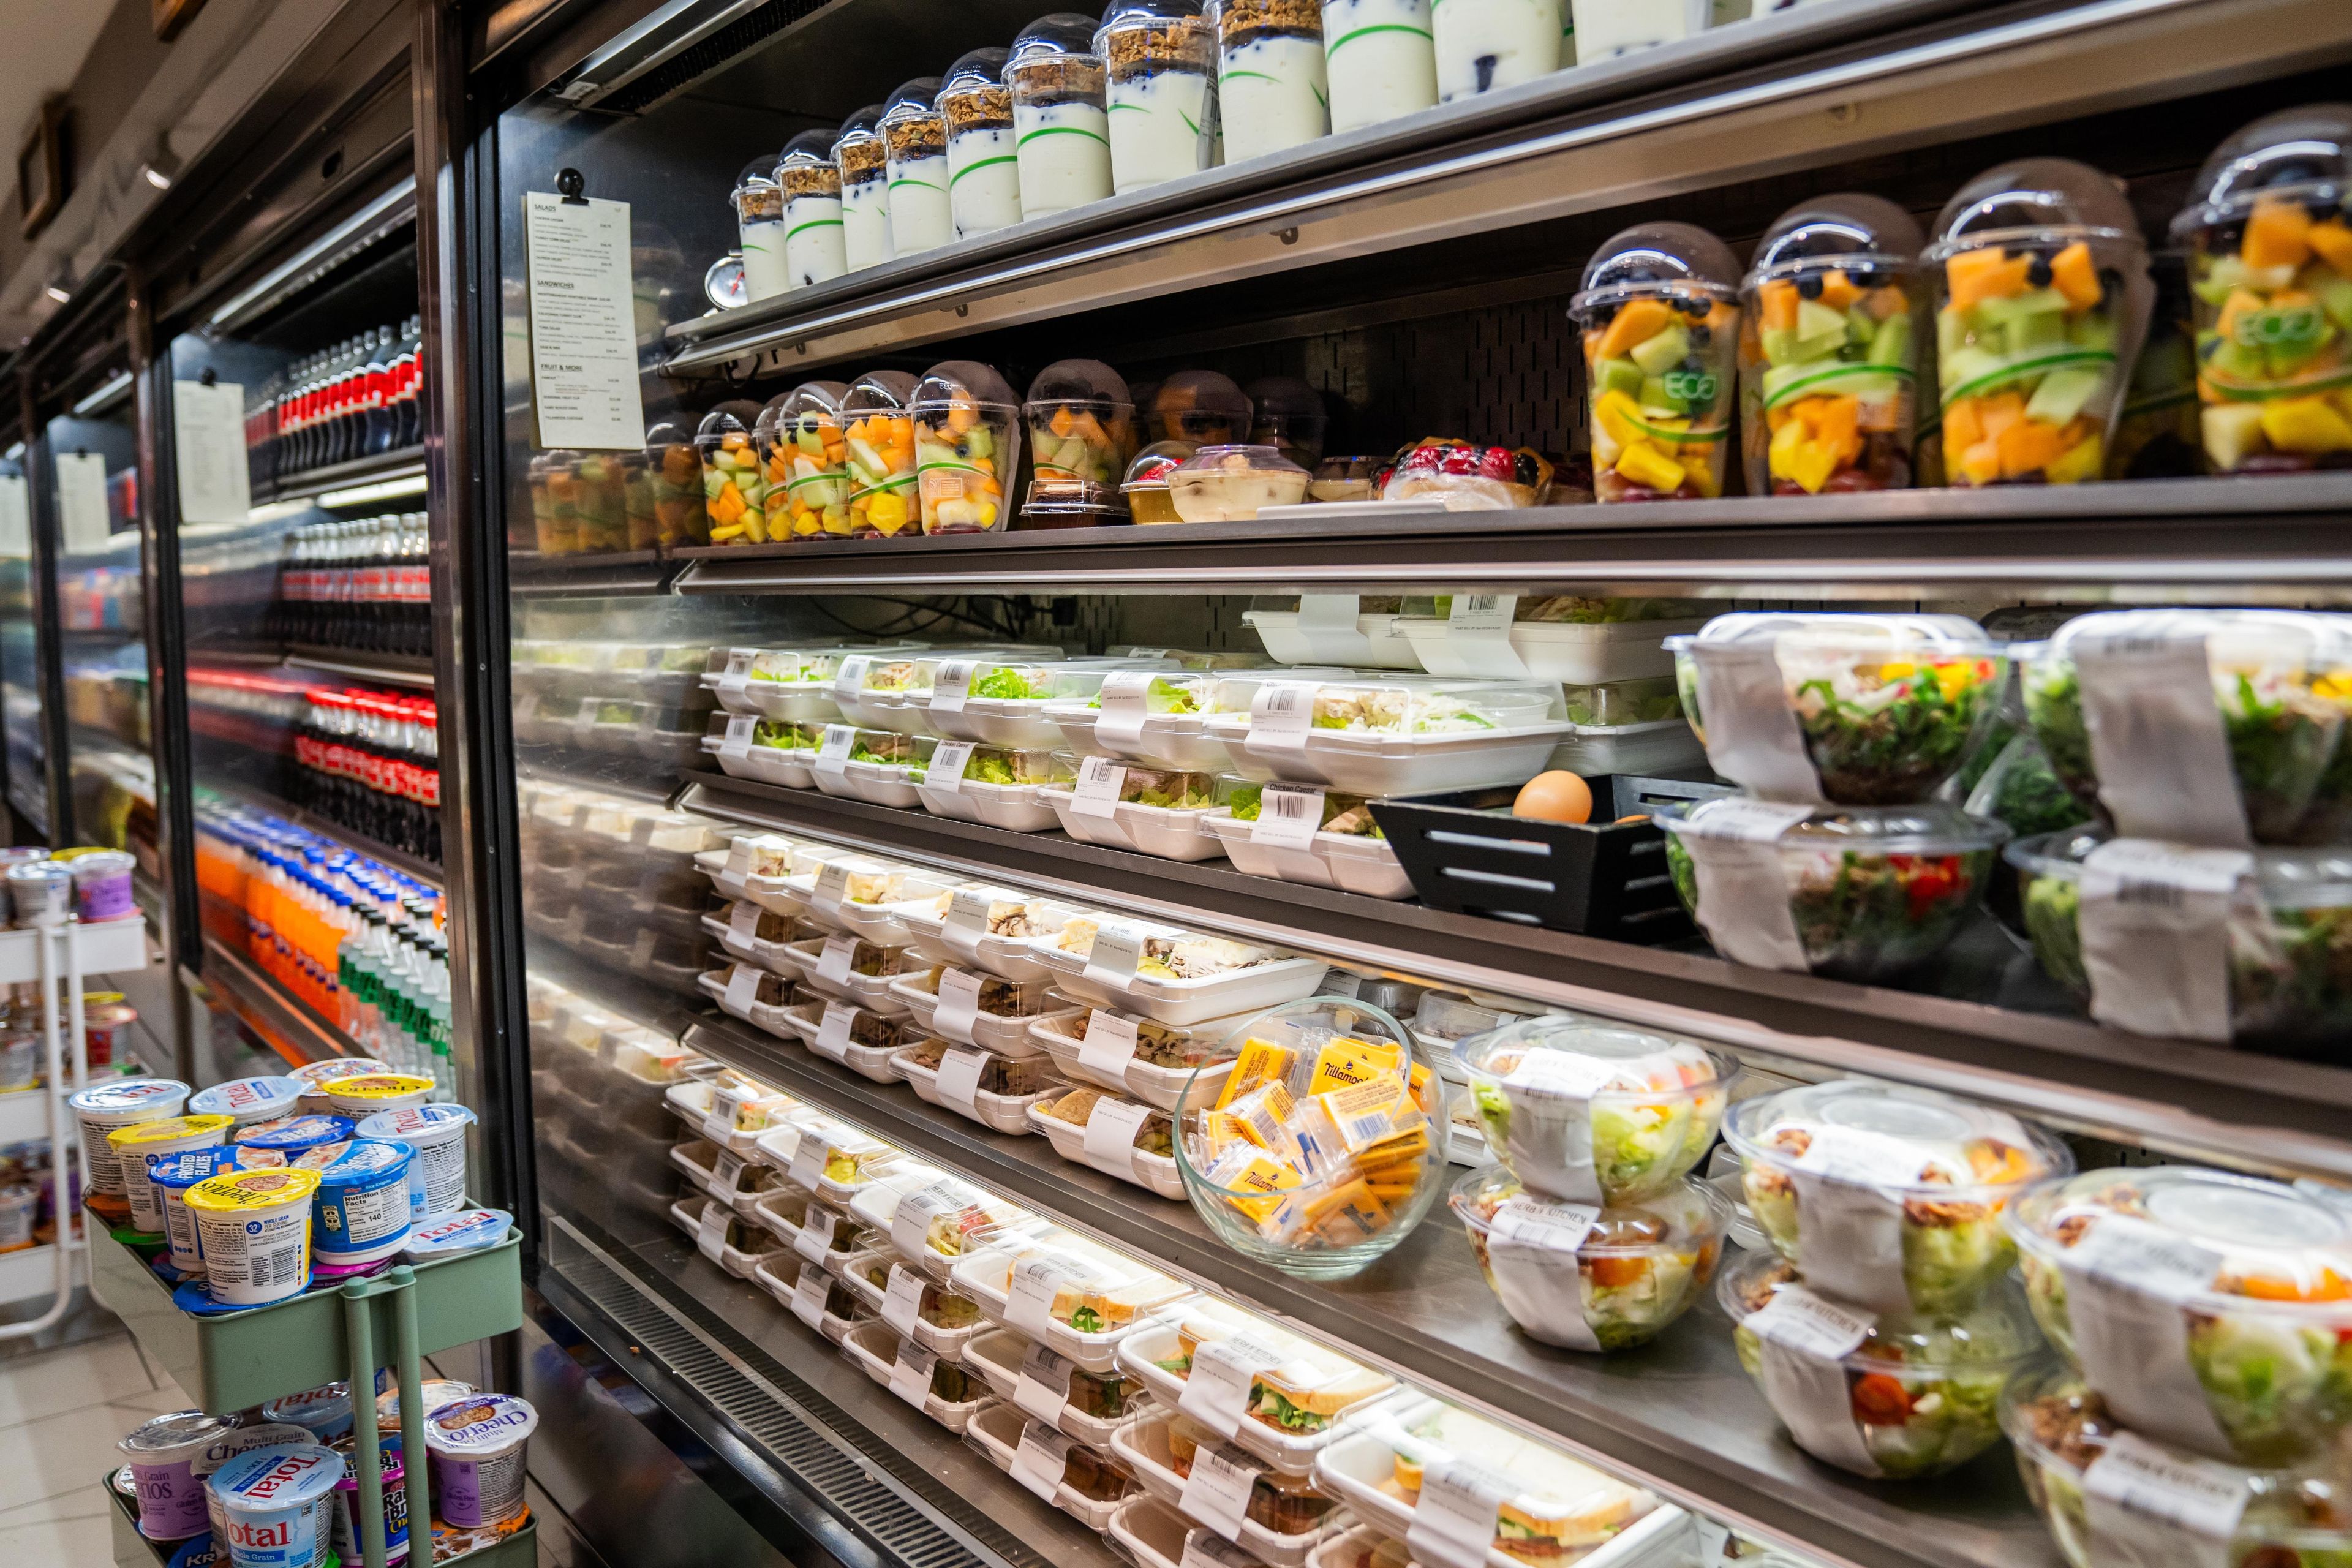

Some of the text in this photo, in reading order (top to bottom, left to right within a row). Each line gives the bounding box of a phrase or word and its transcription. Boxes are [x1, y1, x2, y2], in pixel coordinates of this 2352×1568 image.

[537, 280, 574, 289] SANDWICHES
[1269, 783, 1294, 792] Chicken
[221, 1083, 258, 1107] Total
[389, 1107, 424, 1133] Total
[178, 1155, 196, 1179] FROSTED
[195, 1155, 212, 1175] FLAKES
[194, 1182, 271, 1205] Cheerios
[375, 1178, 391, 1187] Krispies
[344, 1191, 379, 1202] Nutrition
[368, 1213, 382, 1222] 140
[1510, 1201, 1537, 1214] HERB
[1546, 1205, 1587, 1224] KITCHEN
[249, 1224, 258, 1233] 32
[412, 1212, 493, 1240] Total
[1231, 1336, 1250, 1348] HERB
[1254, 1347, 1283, 1365] KITCHEN
[244, 1431, 306, 1445] Multi Grain
[239, 1459, 279, 1488] Whole Grain
[244, 1455, 322, 1499] Total
[226, 1521, 292, 1547] otal
